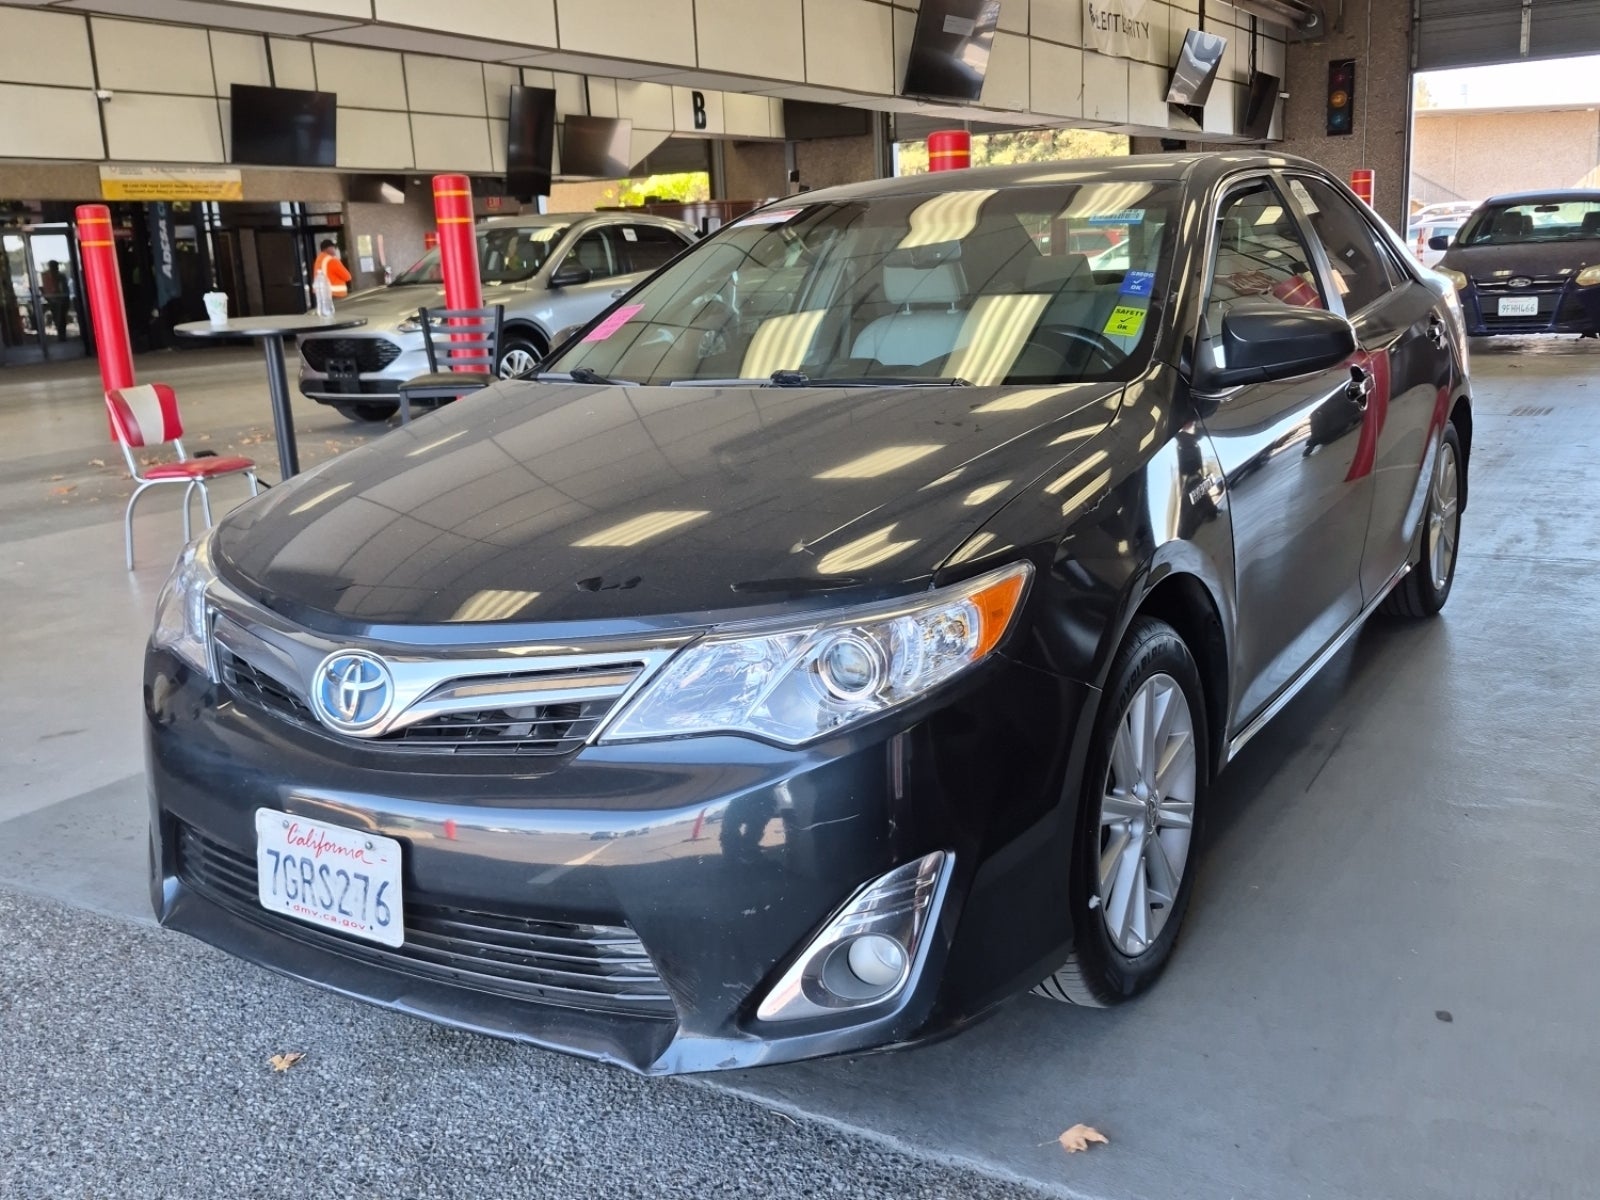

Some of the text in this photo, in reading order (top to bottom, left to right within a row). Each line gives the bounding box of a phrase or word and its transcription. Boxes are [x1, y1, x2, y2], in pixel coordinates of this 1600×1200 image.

[692, 91, 706, 129] B
[159, 219, 172, 278] ADESA
[1115, 308, 1144, 317] SAFETY
[287, 822, 373, 864] California
[267, 848, 391, 927] 7GRS276
[293, 904, 366, 930] dmv.ca.gov
